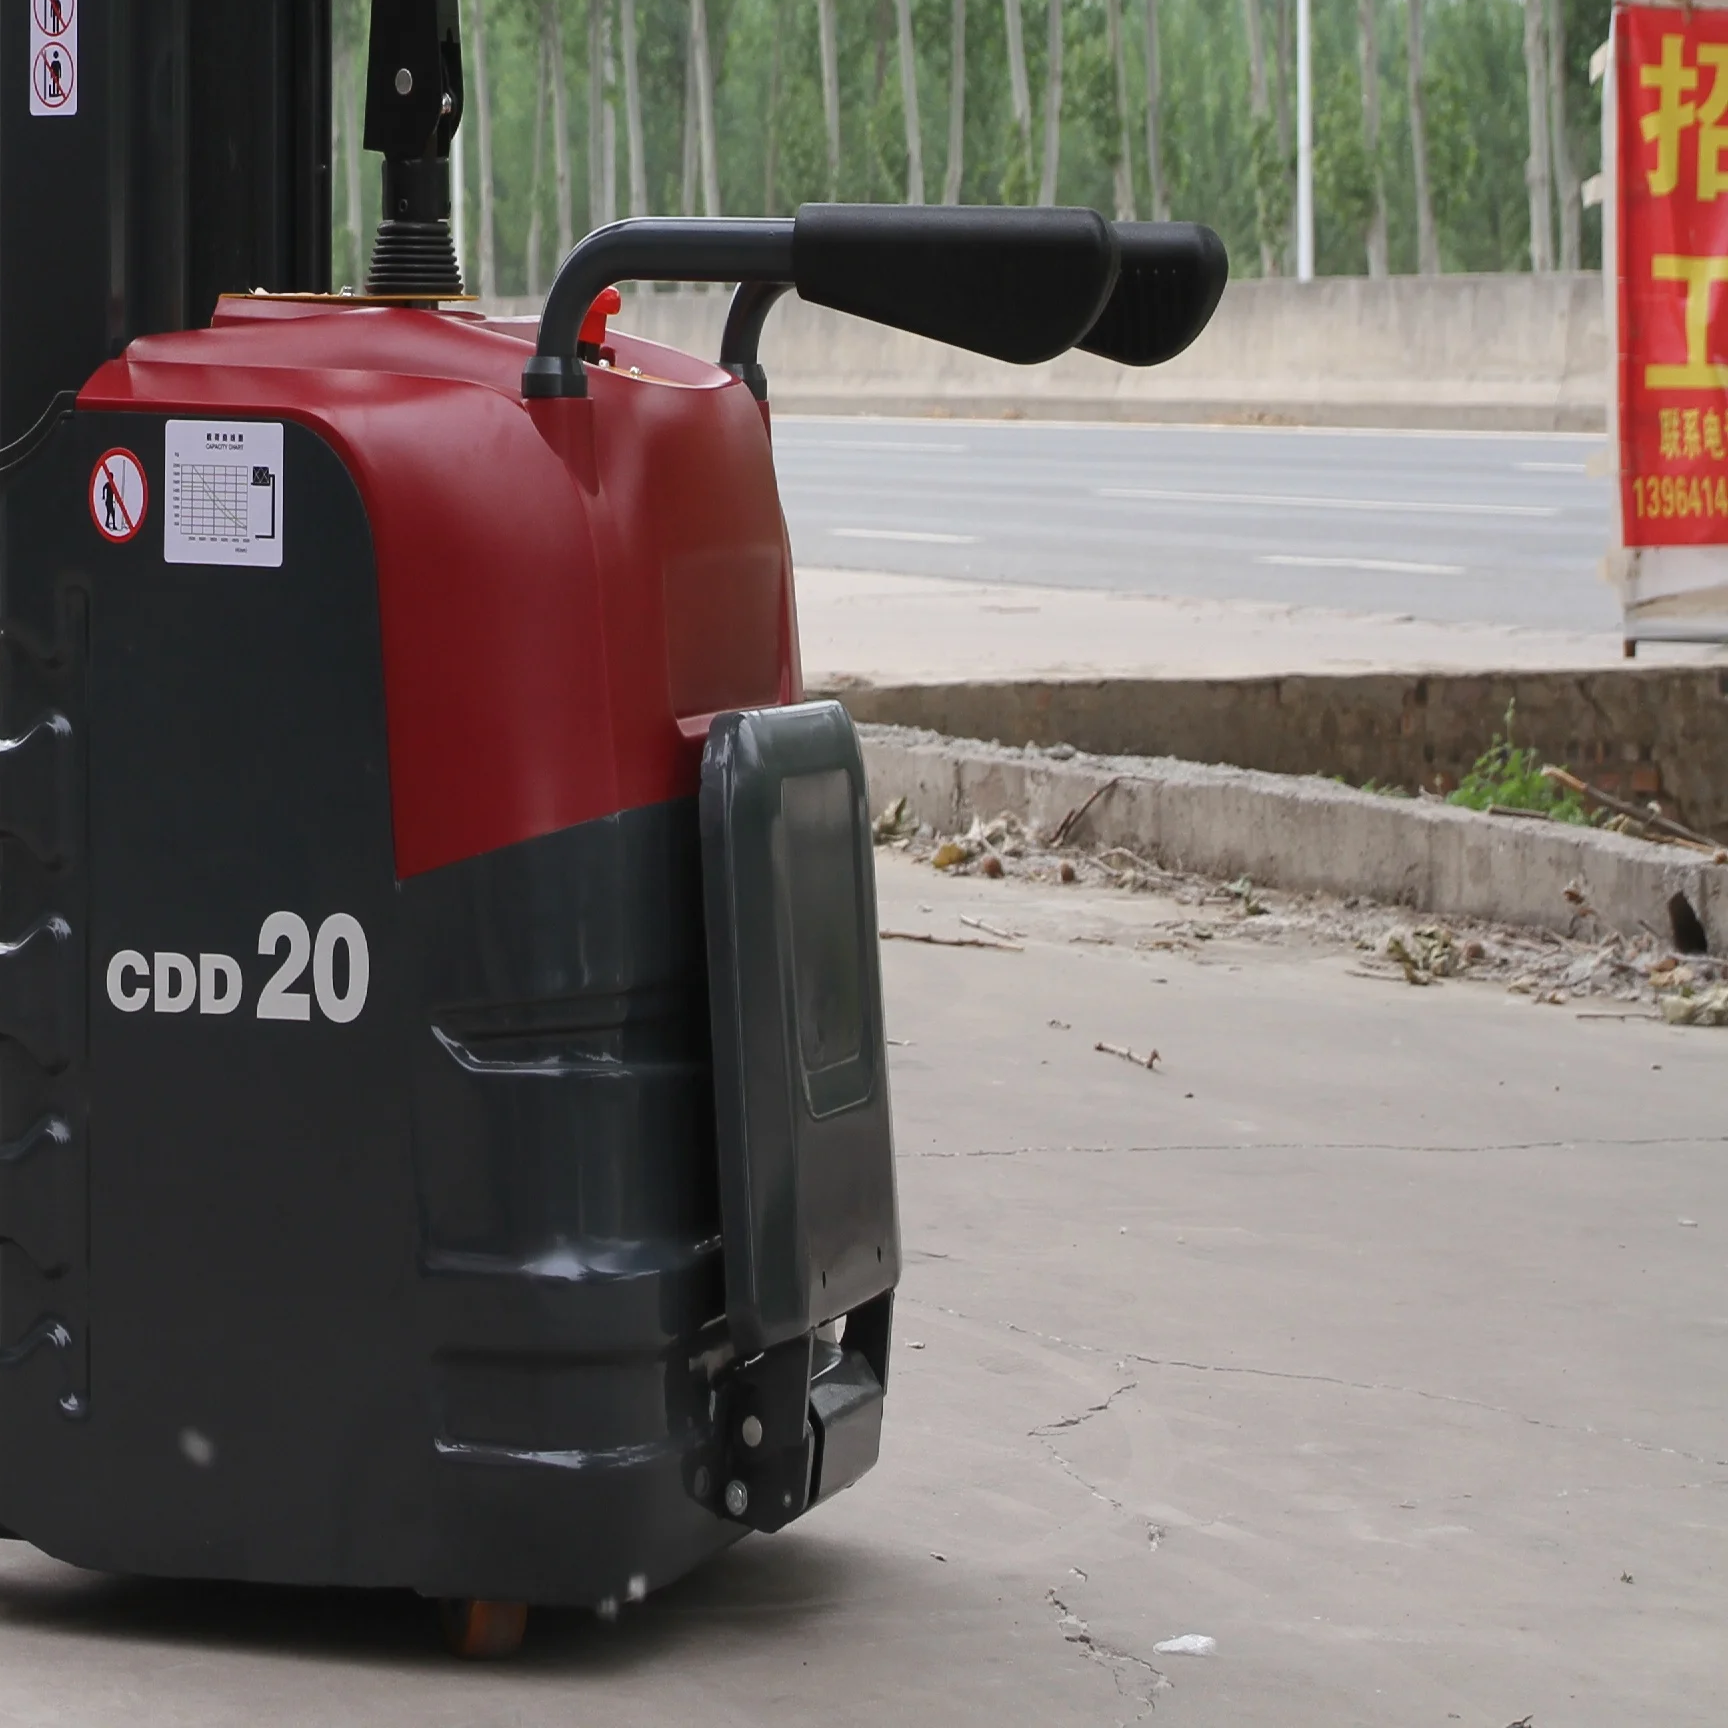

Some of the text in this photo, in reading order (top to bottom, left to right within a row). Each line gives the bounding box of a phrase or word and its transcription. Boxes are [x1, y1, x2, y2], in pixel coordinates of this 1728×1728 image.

[1659, 407, 1728, 460] 联系电
[106, 910, 370, 1024] CDD 20
